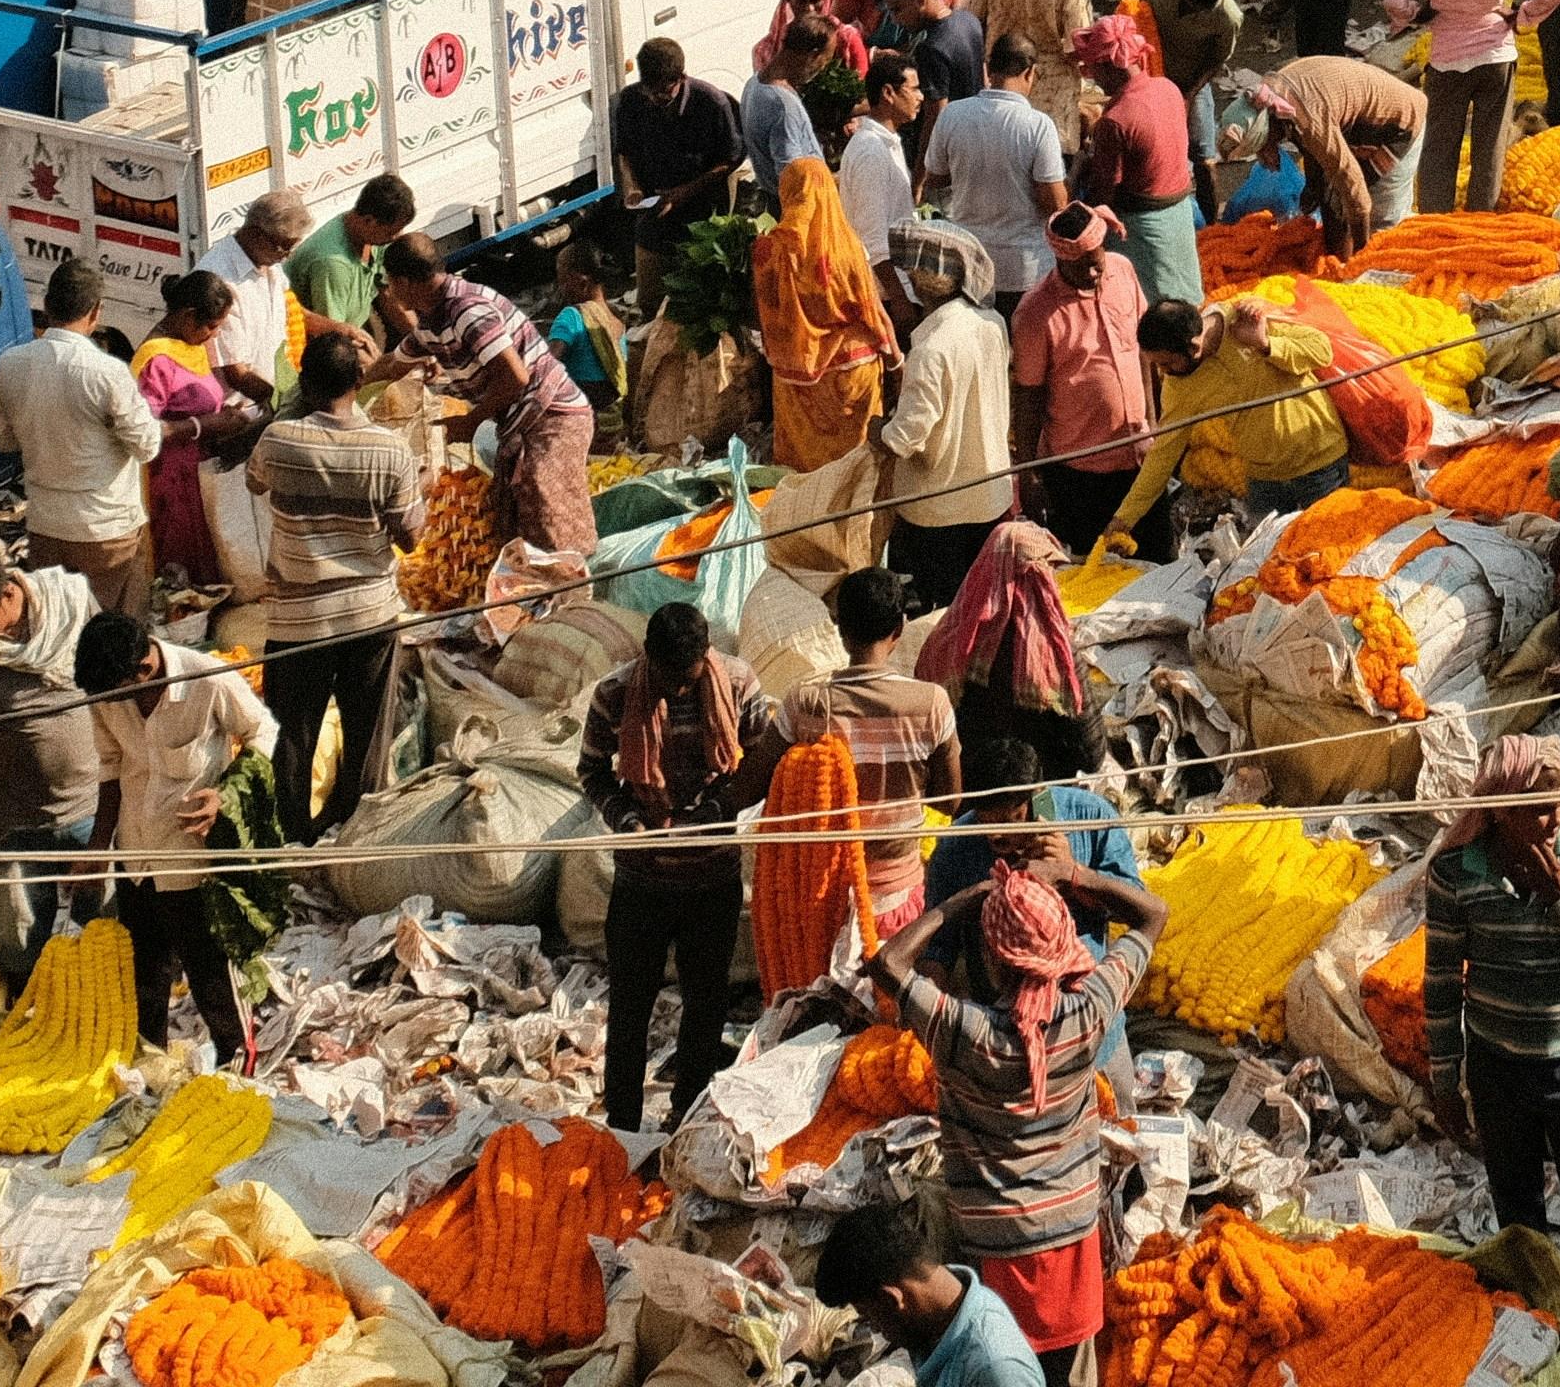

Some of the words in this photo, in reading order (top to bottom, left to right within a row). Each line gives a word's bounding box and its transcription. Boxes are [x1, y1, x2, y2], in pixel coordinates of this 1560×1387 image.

[284, 77, 380, 159] For
[98, 253, 132, 278] Save
[136, 260, 168, 287] Lif
